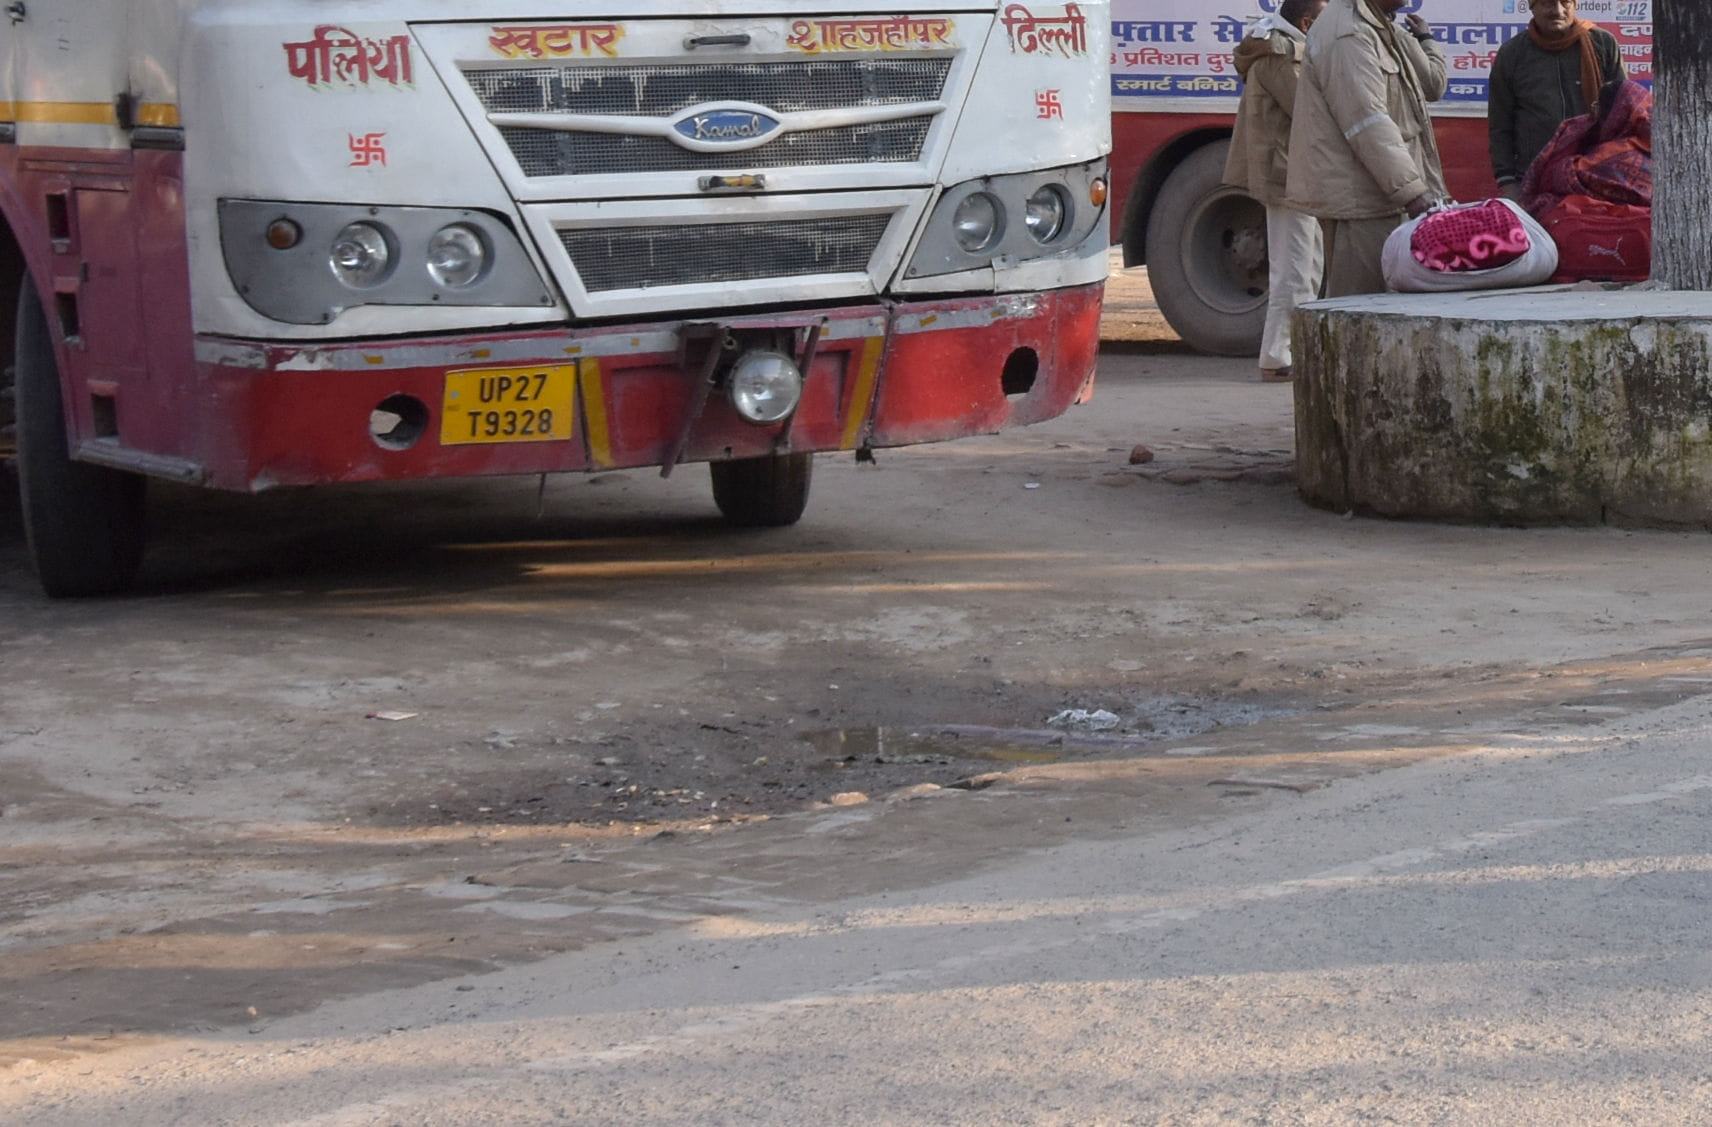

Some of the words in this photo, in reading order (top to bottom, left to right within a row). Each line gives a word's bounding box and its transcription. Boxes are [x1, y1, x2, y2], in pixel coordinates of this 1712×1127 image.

[1628, 2, 1648, 16] 112
[489, 25, 624, 59] खुटार
[1001, 2, 1088, 59] दिल्ली
[1210, 15, 1248, 43] से
[283, 25, 414, 87] पलिया
[1123, 47, 1200, 68] प्रतिशत
[1116, 76, 1172, 91] स्मार्ट
[1176, 76, 1238, 91] बनिये
[1448, 83, 1485, 95] का
[693, 115, 762, 139] Kamal
[479, 373, 548, 403] UP27
[468, 408, 553, 437] T9328
